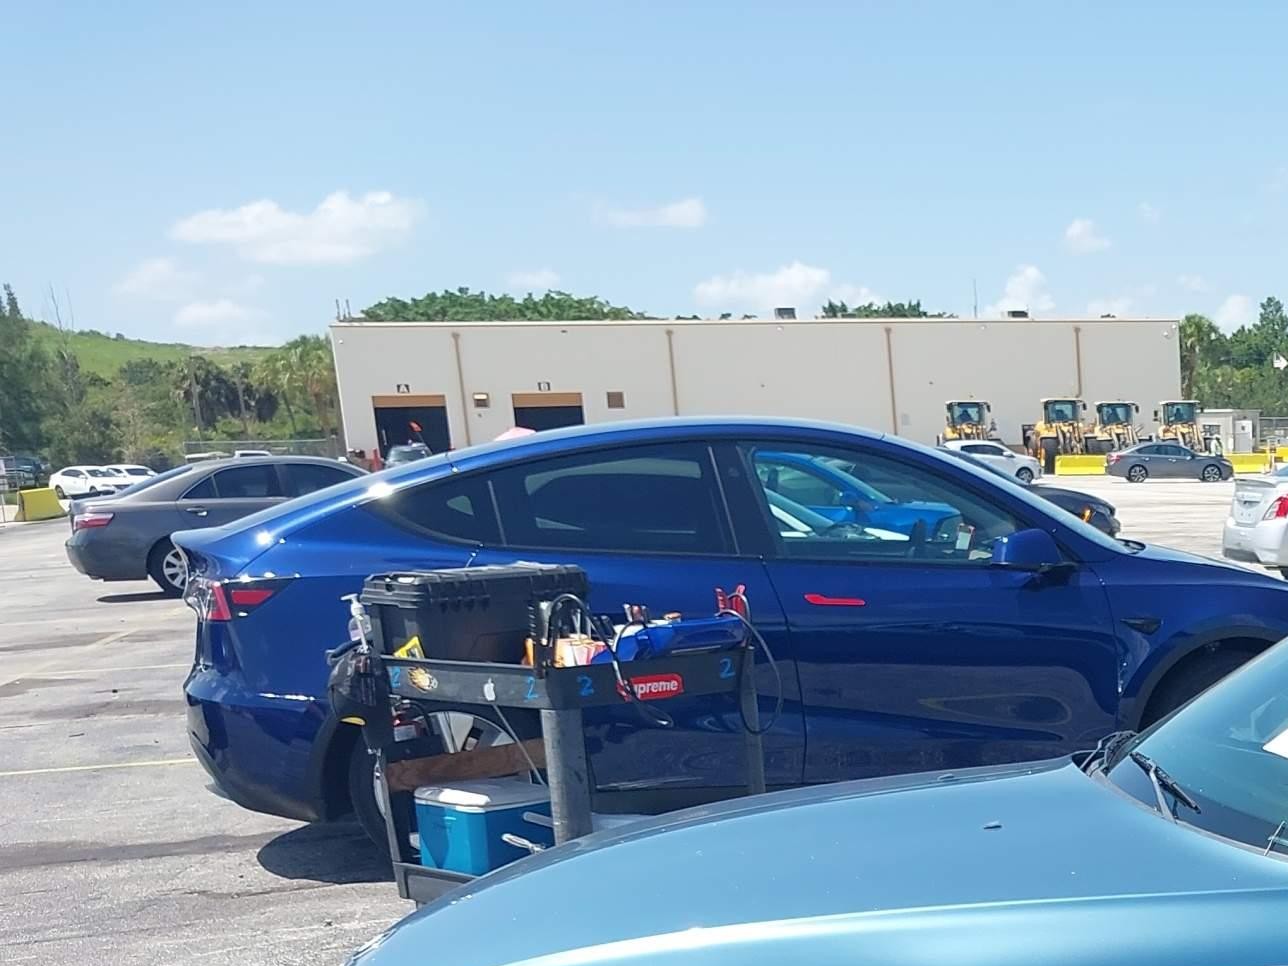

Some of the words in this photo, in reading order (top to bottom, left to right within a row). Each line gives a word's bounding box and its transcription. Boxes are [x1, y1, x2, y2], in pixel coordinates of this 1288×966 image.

[720, 659, 736, 680] 2
[524, 676, 539, 700] 2
[577, 675, 595, 697] 2
